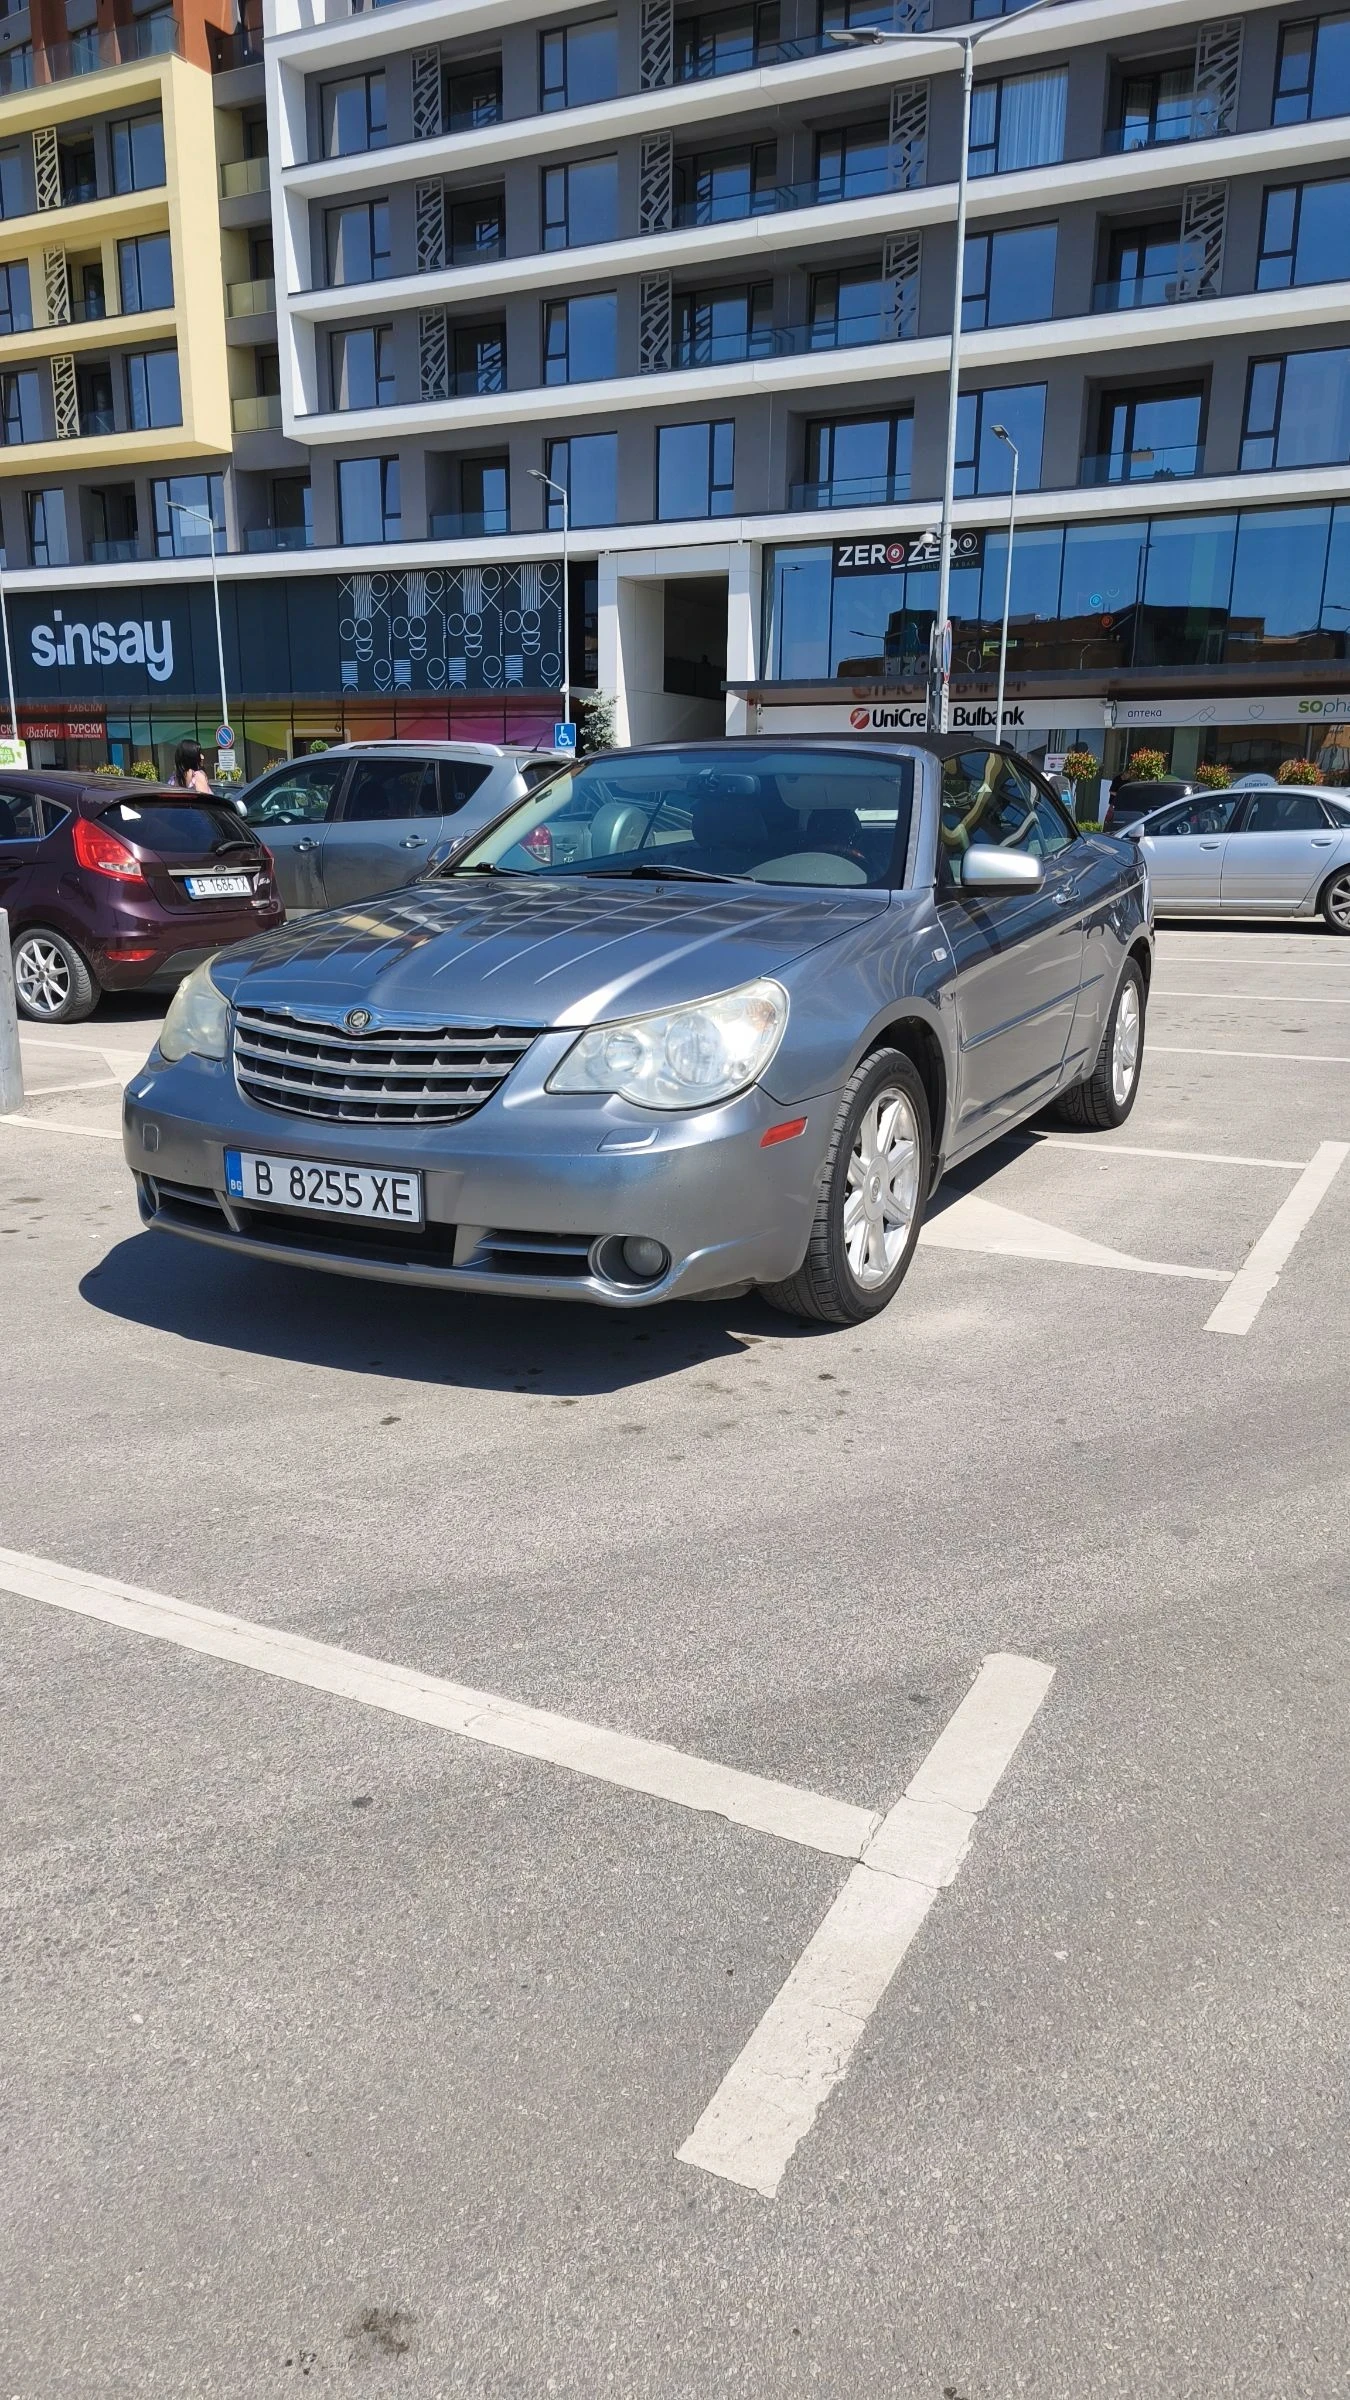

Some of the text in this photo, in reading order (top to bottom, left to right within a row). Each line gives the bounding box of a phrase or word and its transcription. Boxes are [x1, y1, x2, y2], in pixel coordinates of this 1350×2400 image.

[838, 543, 905, 567] ZERO
[31, 609, 174, 682] sinsay
[872, 705, 1025, 728] UniCre Bulbank
[1127, 707, 1162, 718] аптека
[1297, 697, 1350, 717] soph
[67, 723, 103, 734] ТУРСКИ
[197, 879, 206, 893] B
[210, 877, 234, 892] 1686
[230, 1179, 243, 1191] BG
[254, 1160, 413, 1216] B 8255 XE
